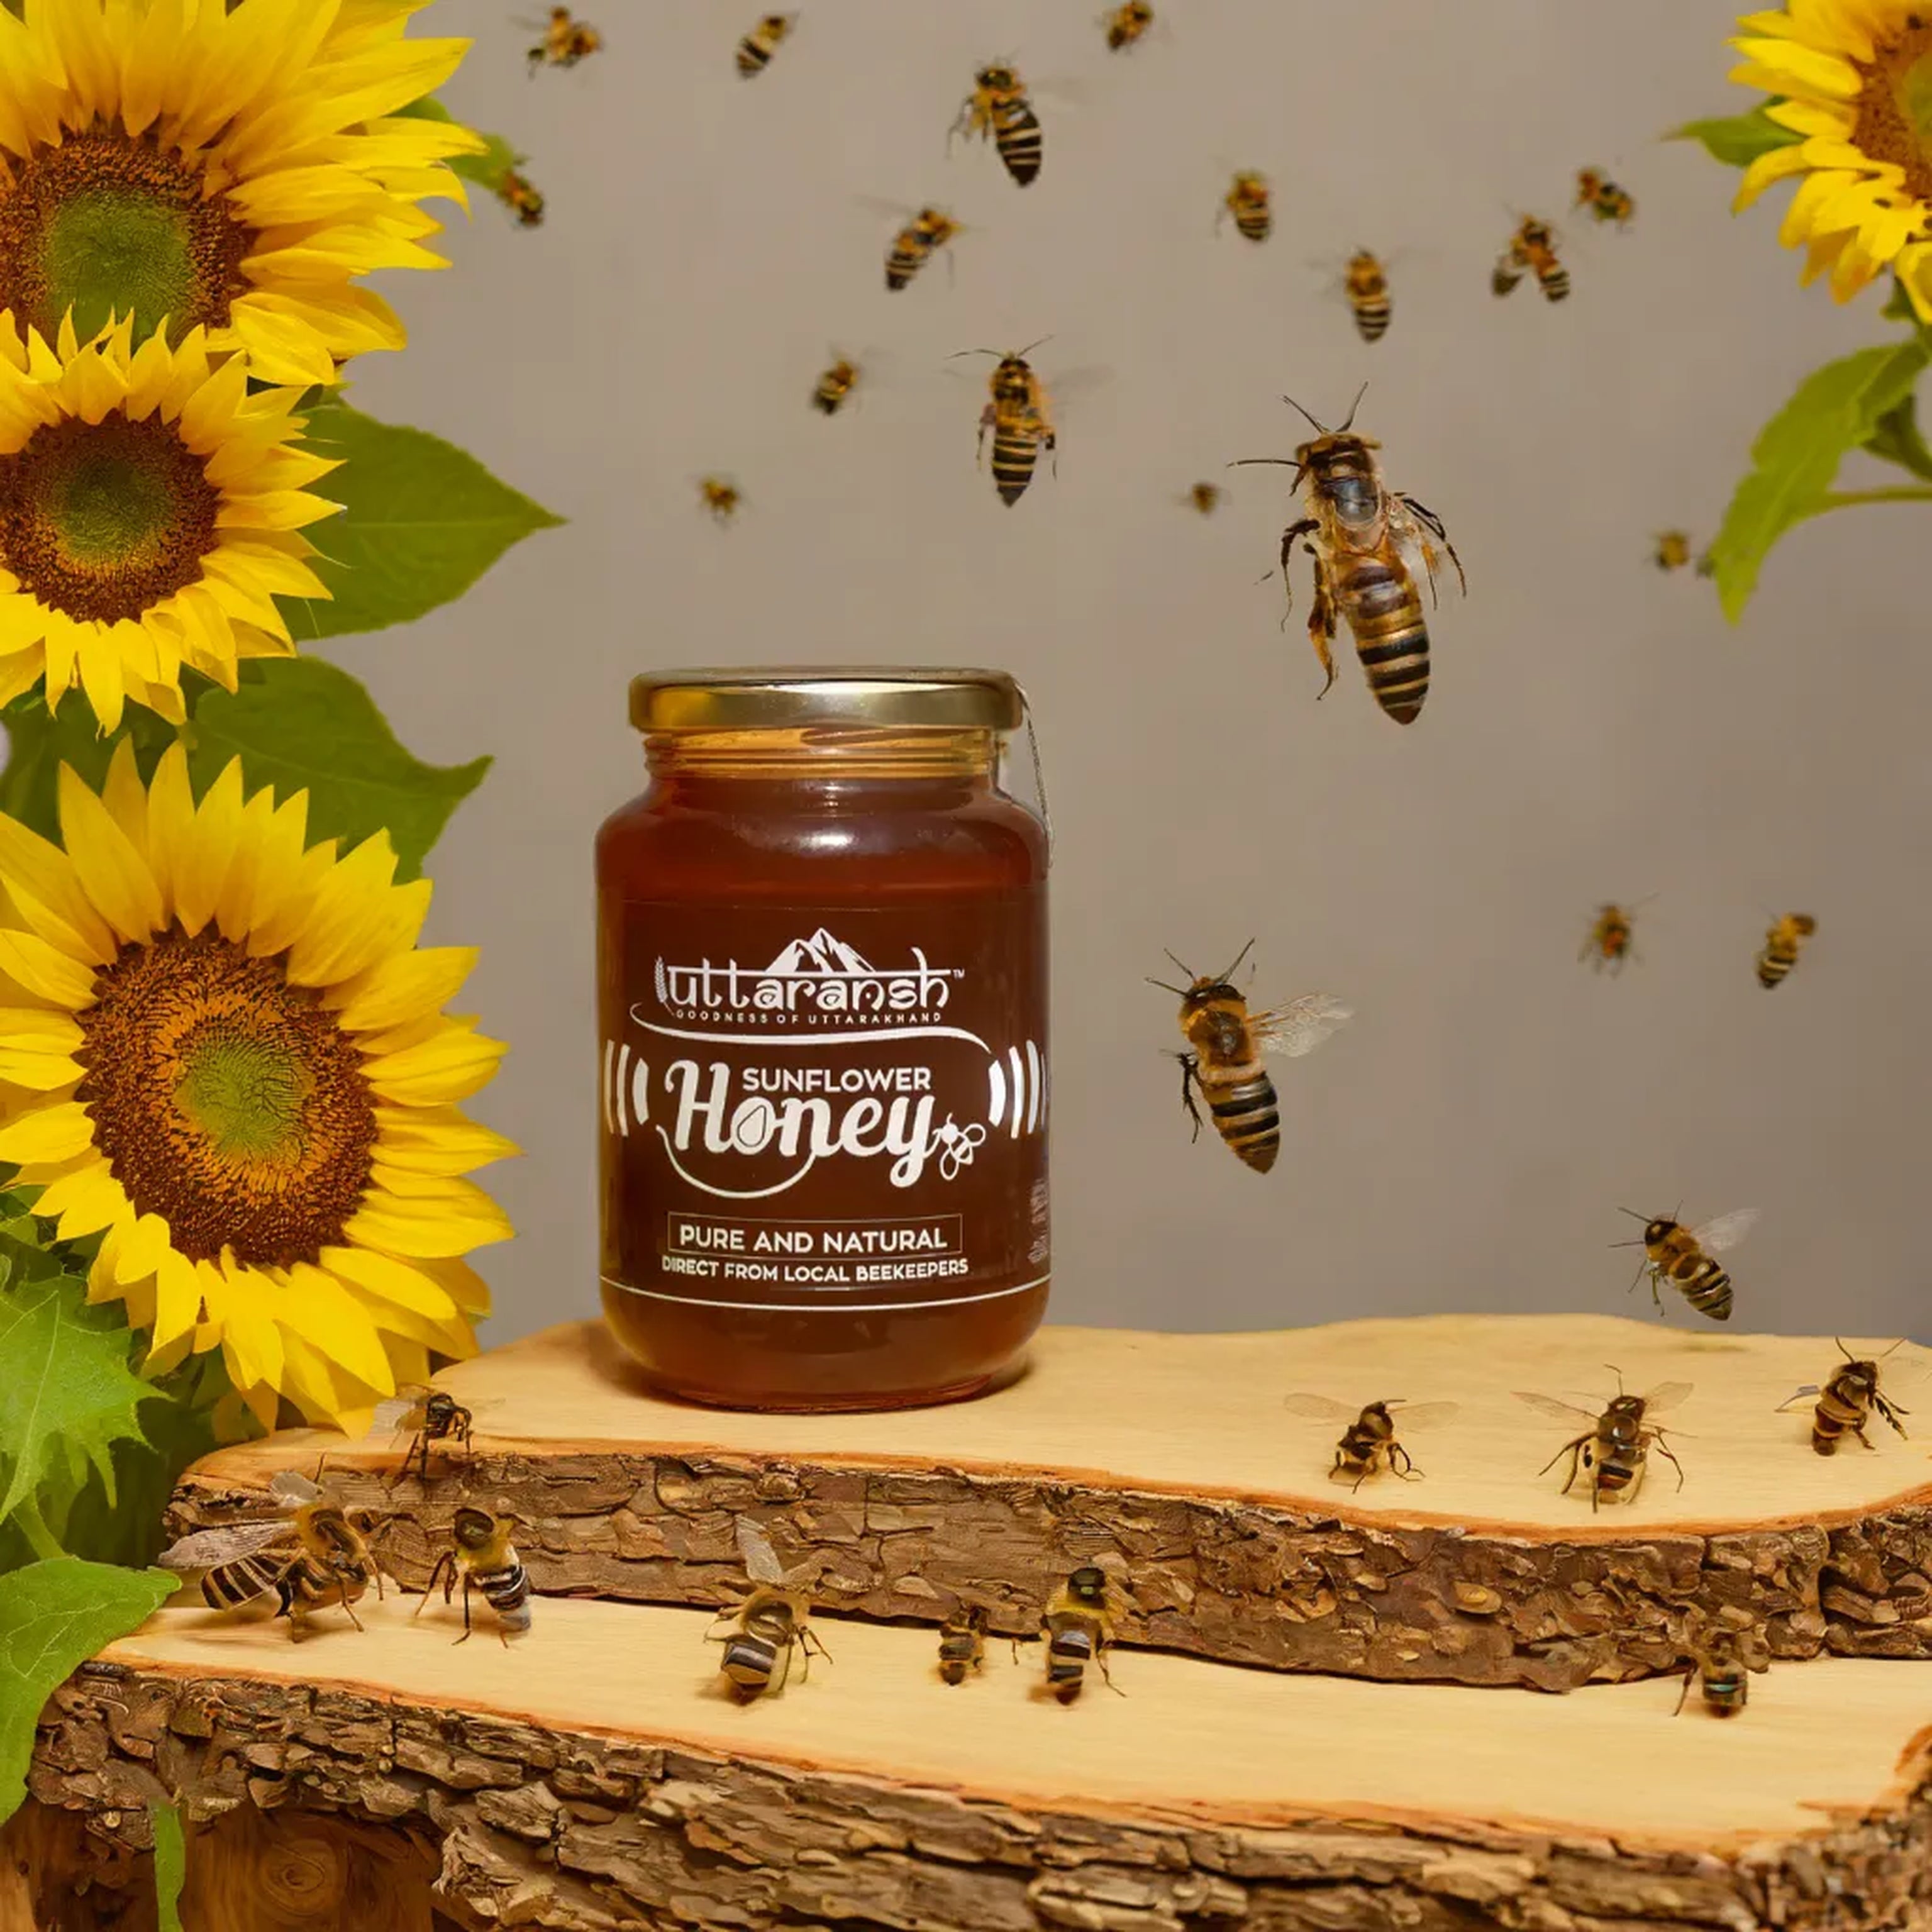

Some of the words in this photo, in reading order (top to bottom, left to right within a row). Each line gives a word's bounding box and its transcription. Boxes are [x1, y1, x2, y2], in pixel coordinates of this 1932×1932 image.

[676, 1009, 768, 1023] GOODNESS
[777, 1014, 799, 1024] OF
[808, 1012, 941, 1024] UTTARAKHAND
[742, 1067, 931, 1092] SUNFLOWER
[664, 1059, 936, 1188] Honey
[680, 1224, 745, 1250] PURE
[753, 1231, 814, 1253] AND
[823, 1228, 948, 1253] NATURAL
[662, 1255, 719, 1277] DIRECT
[724, 1263, 778, 1280] FROM
[784, 1265, 850, 1282] LOCAL
[856, 1258, 969, 1282] BEEKEEPERS
